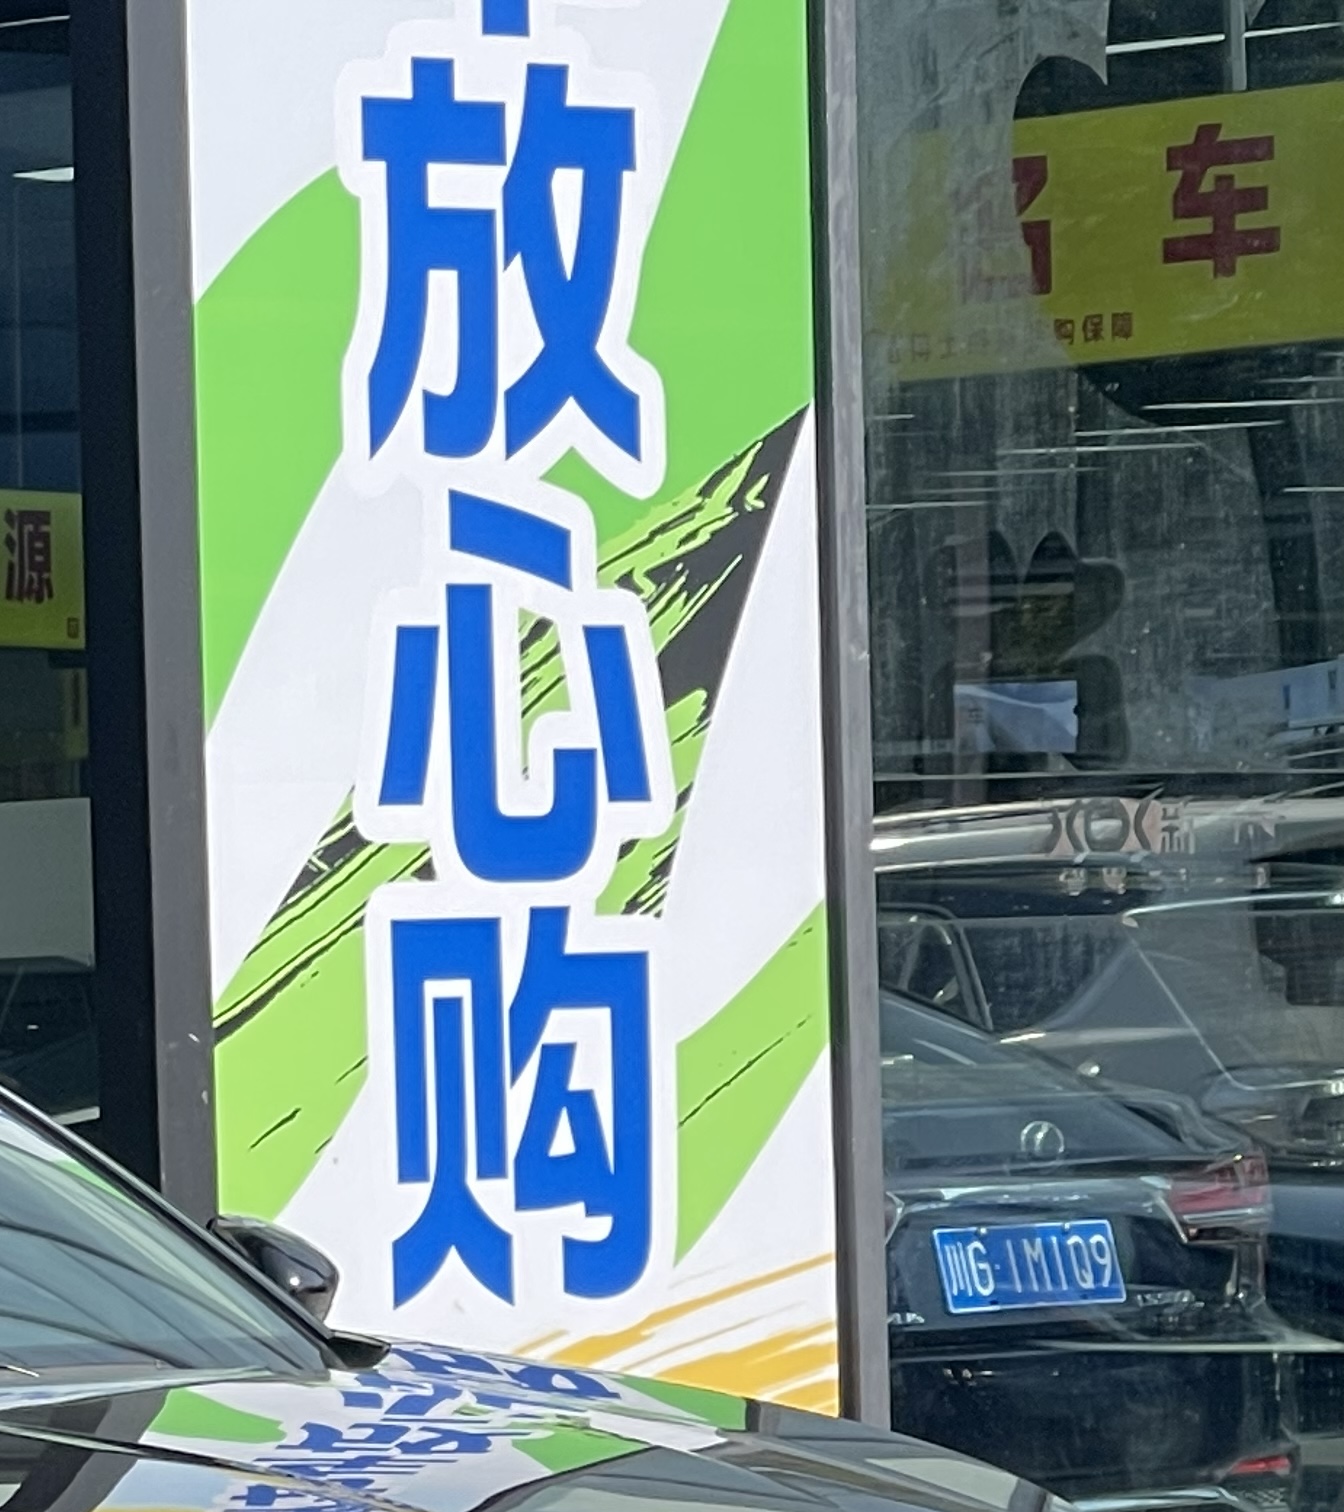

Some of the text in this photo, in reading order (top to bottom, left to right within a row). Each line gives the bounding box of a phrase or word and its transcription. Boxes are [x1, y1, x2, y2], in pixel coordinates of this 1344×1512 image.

[4, 508, 55, 604] 源
[361, 0, 650, 1303] 放心购
